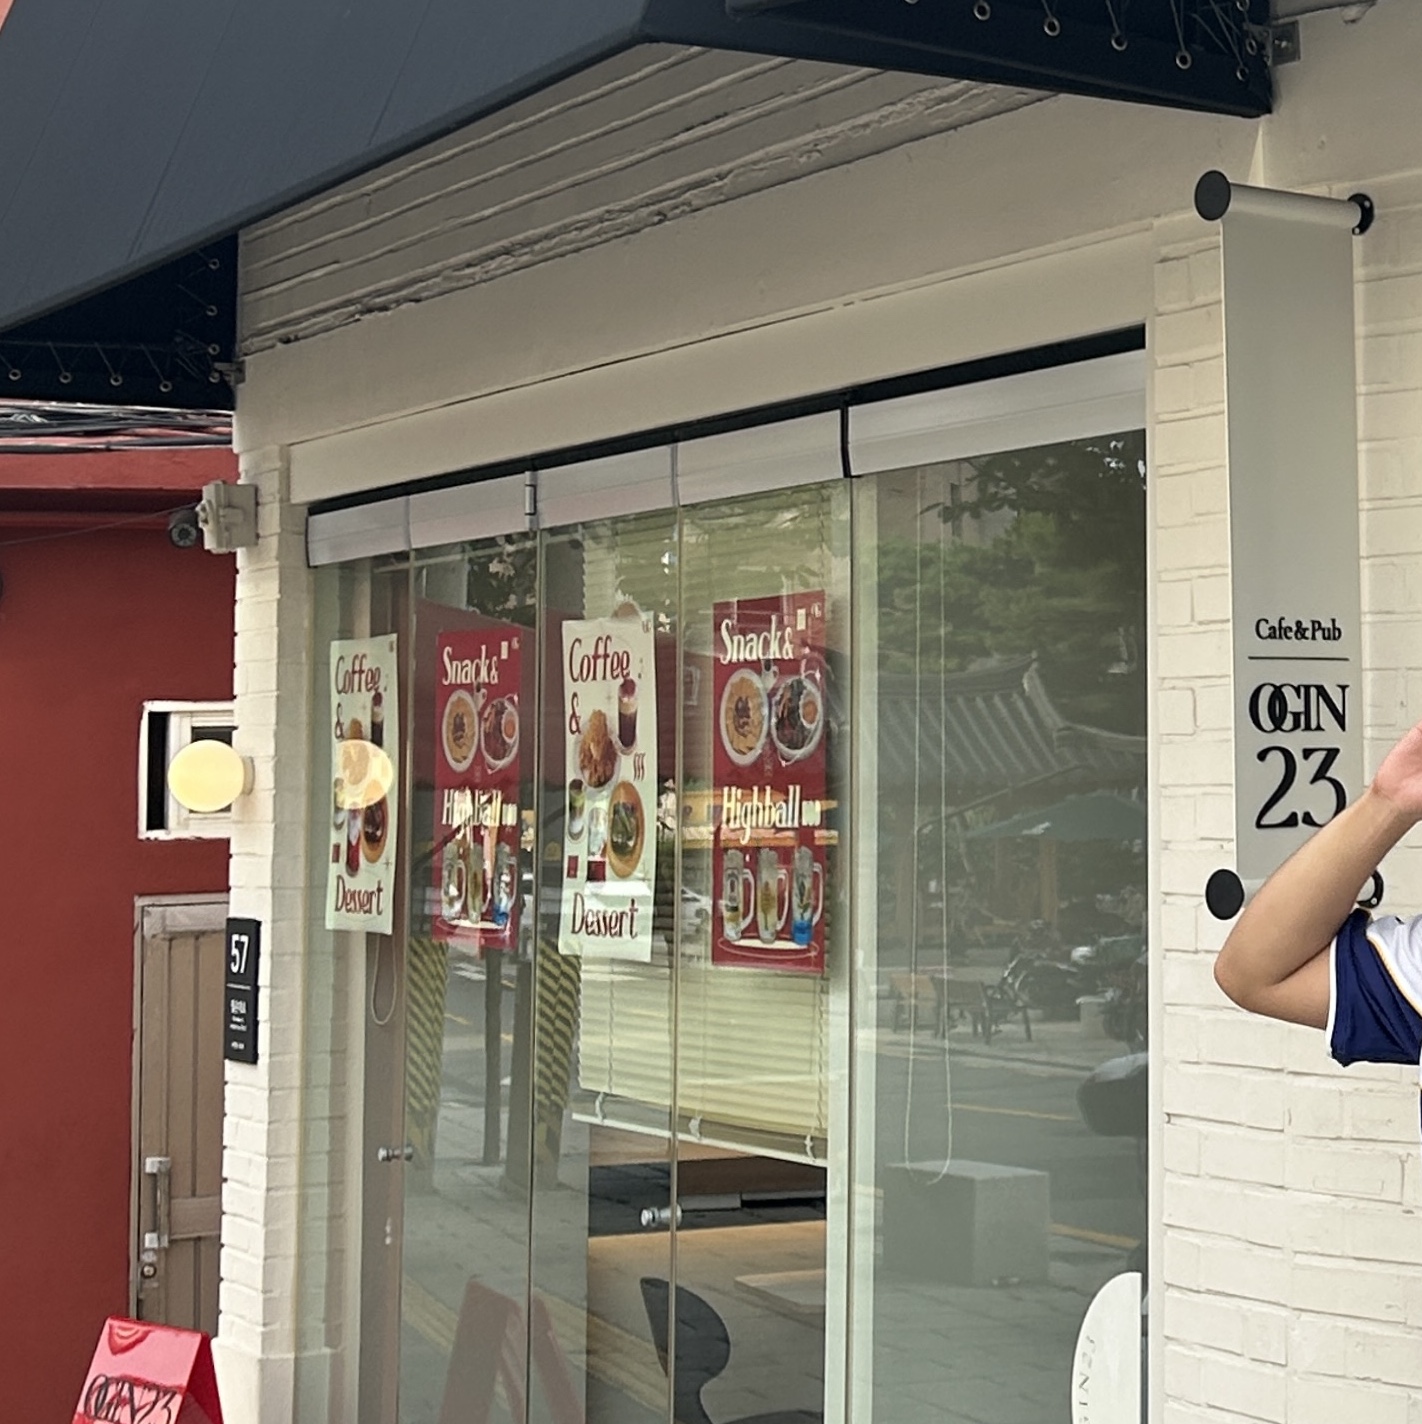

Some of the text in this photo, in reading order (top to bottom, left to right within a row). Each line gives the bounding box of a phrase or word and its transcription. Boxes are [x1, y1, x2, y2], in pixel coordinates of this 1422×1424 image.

[1255, 616, 1343, 642] Cafe&Pub
[334, 653, 383, 695] Coffee
[568, 634, 631, 683] Coffee
[568, 691, 582, 735] &
[1249, 682, 1351, 734] OGIN
[1255, 745, 1348, 830] 23
[722, 785, 801, 846] Highball
[334, 874, 384, 917] Dessert
[570, 891, 639, 940] Dessert
[230, 933, 249, 974] 57
